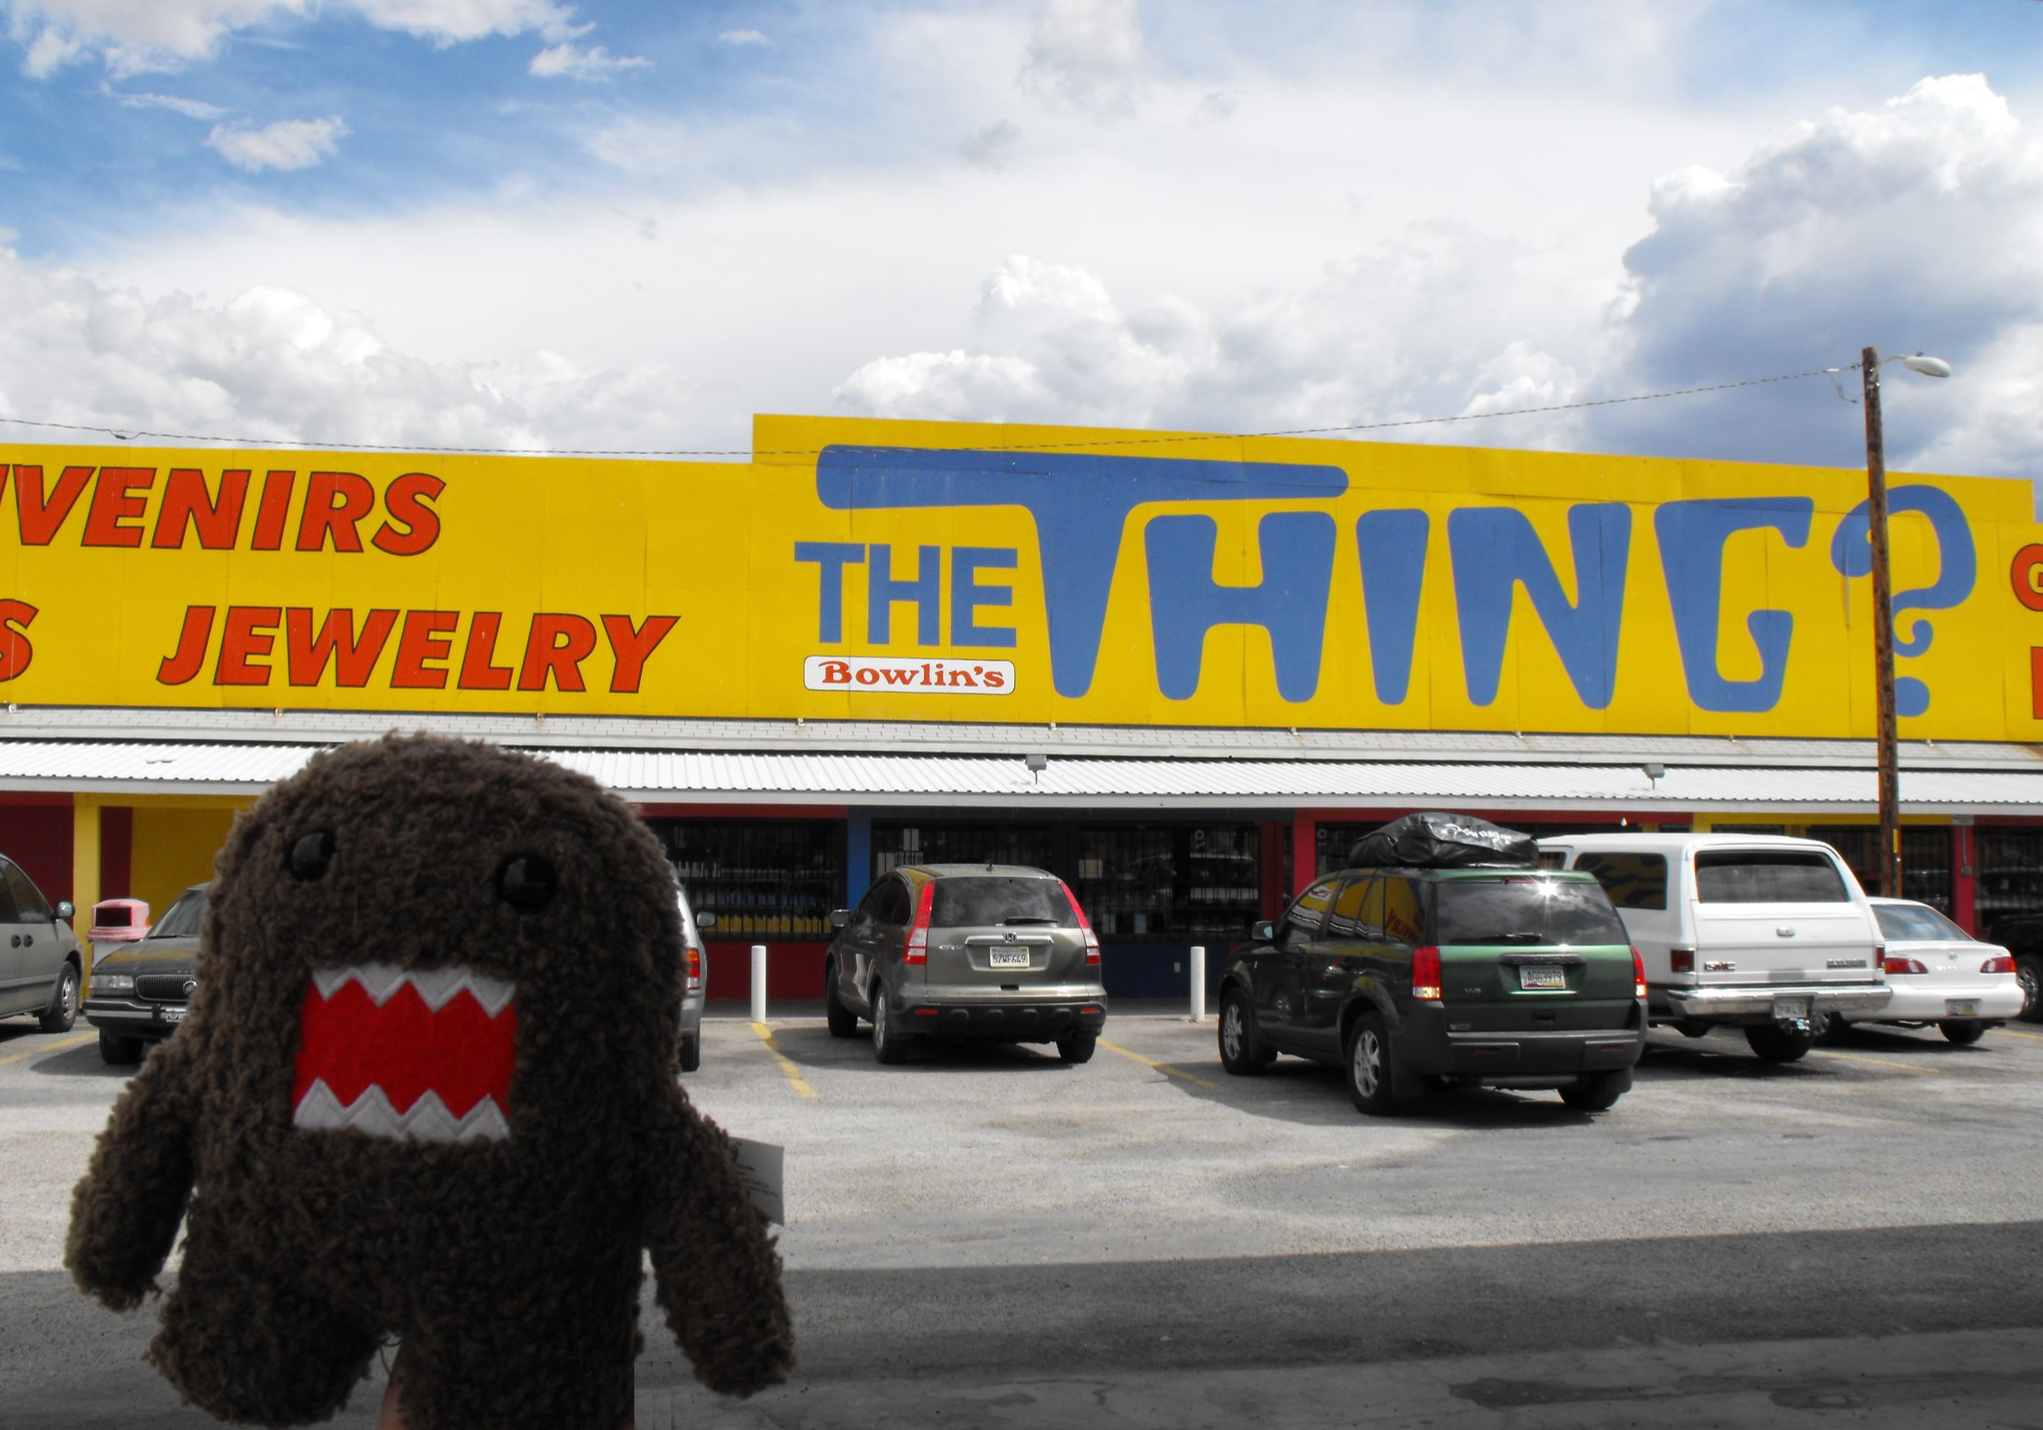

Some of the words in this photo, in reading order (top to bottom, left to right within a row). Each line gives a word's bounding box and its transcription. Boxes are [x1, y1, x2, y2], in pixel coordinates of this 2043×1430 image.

[0, 463, 447, 557] VENIRS
[794, 540, 1018, 648] THE
[815, 443, 1978, 717] THING?
[156, 604, 682, 694] JEWELRY
[818, 660, 1005, 688] Bowlin's
